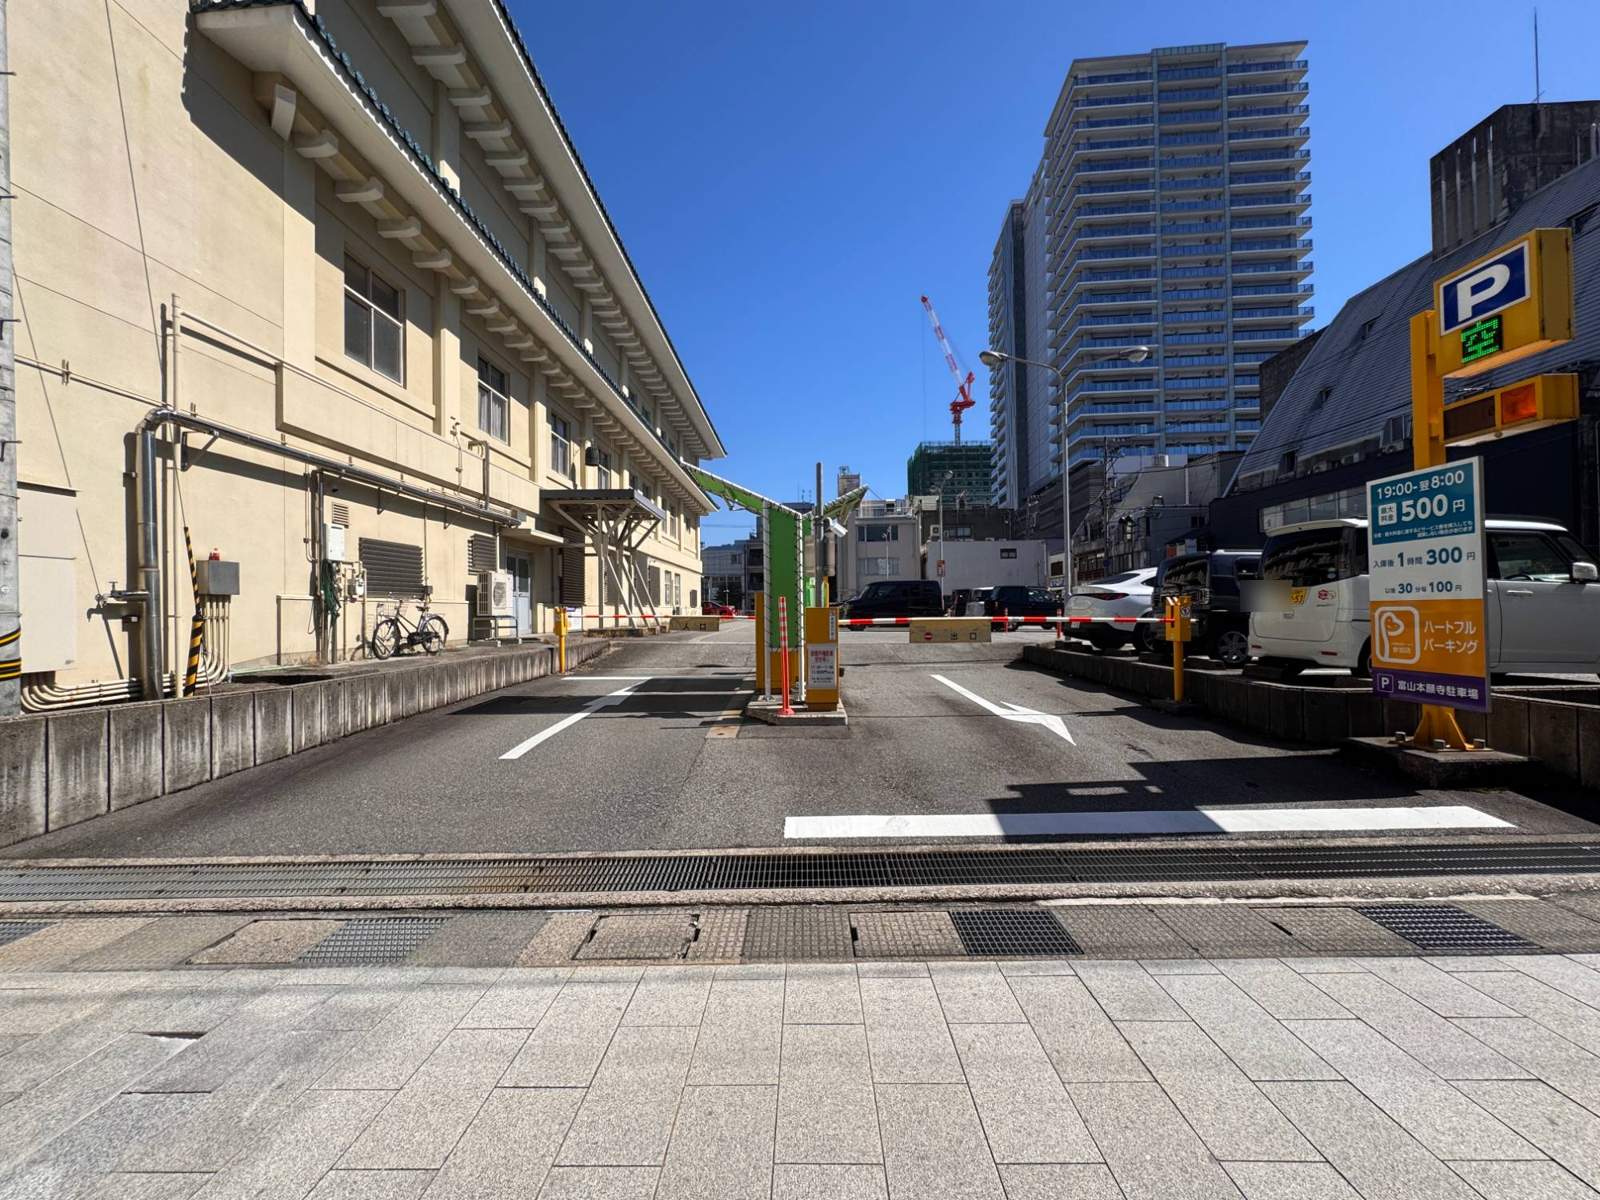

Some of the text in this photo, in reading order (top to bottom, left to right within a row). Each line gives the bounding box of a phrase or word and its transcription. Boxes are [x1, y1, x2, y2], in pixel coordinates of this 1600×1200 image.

[1456, 263, 1511, 323] P
[1460, 320, 1500, 364] 空
[1424, 620, 1477, 636] ハートフル
[1423, 638, 1479, 655] パーキング
[1397, 680, 1479, 700] 富山本願寺駐車場
